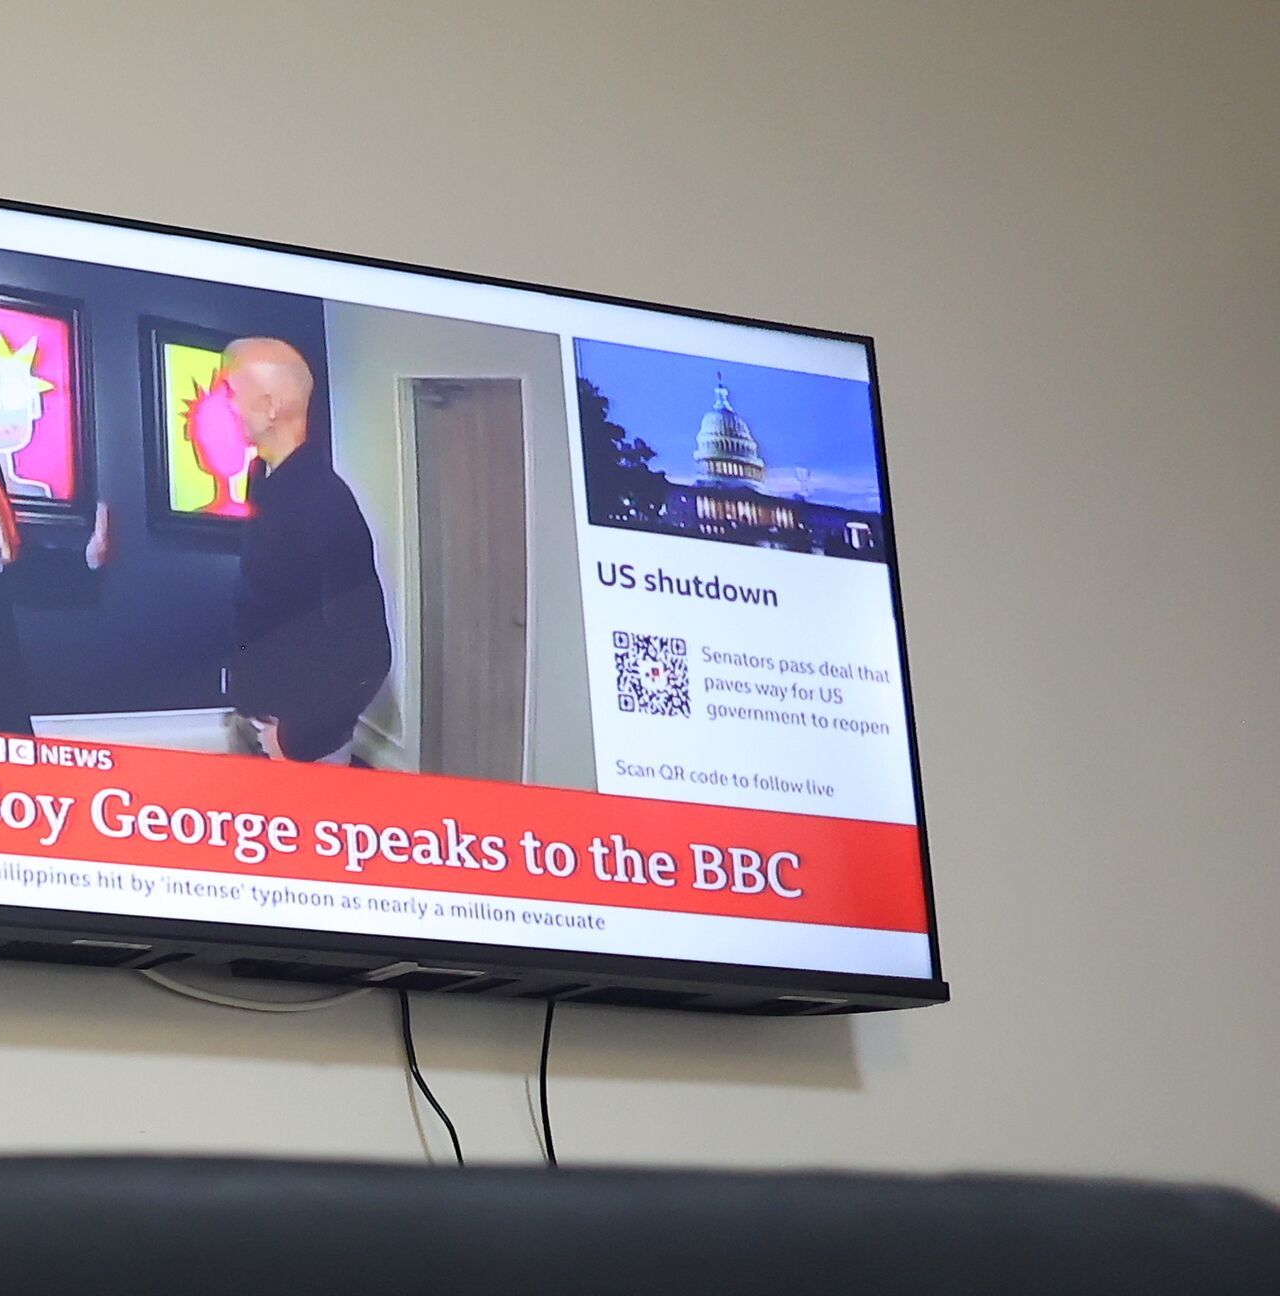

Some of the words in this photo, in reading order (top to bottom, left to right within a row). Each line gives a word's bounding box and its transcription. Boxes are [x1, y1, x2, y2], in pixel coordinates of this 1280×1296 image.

[597, 561, 636, 589] US
[644, 568, 779, 607] shutdown
[700, 646, 775, 670] Senators
[779, 659, 815, 675] pass
[819, 661, 853, 679] deal
[858, 666, 890, 683] that
[704, 676, 752, 694] paves
[755, 683, 788, 702] way
[792, 682, 815, 701] for
[819, 686, 844, 704] US
[706, 703, 807, 726] government
[811, 712, 829, 729] to
[832, 717, 890, 736] reopen
[40, 744, 114, 771] NEWS
[616, 759, 655, 777] Scan
[658, 763, 685, 781] QR
[689, 770, 728, 786] code
[732, 773, 749, 789] to
[753, 773, 803, 794] follow
[806, 779, 835, 797] live
[90, 788, 298, 863] George
[314, 818, 507, 872] speaks
[519, 830, 576, 878] to
[587, 834, 676, 886] the
[689, 842, 804, 899] BBC
[97, 870, 123, 890] hit
[131, 876, 155, 898] by
[251, 885, 334, 909] typhoon
[341, 894, 361, 909] as
[368, 897, 428, 919] nearly
[434, 903, 445, 917] a
[451, 902, 515, 923] million
[522, 909, 606, 931] evacuate
